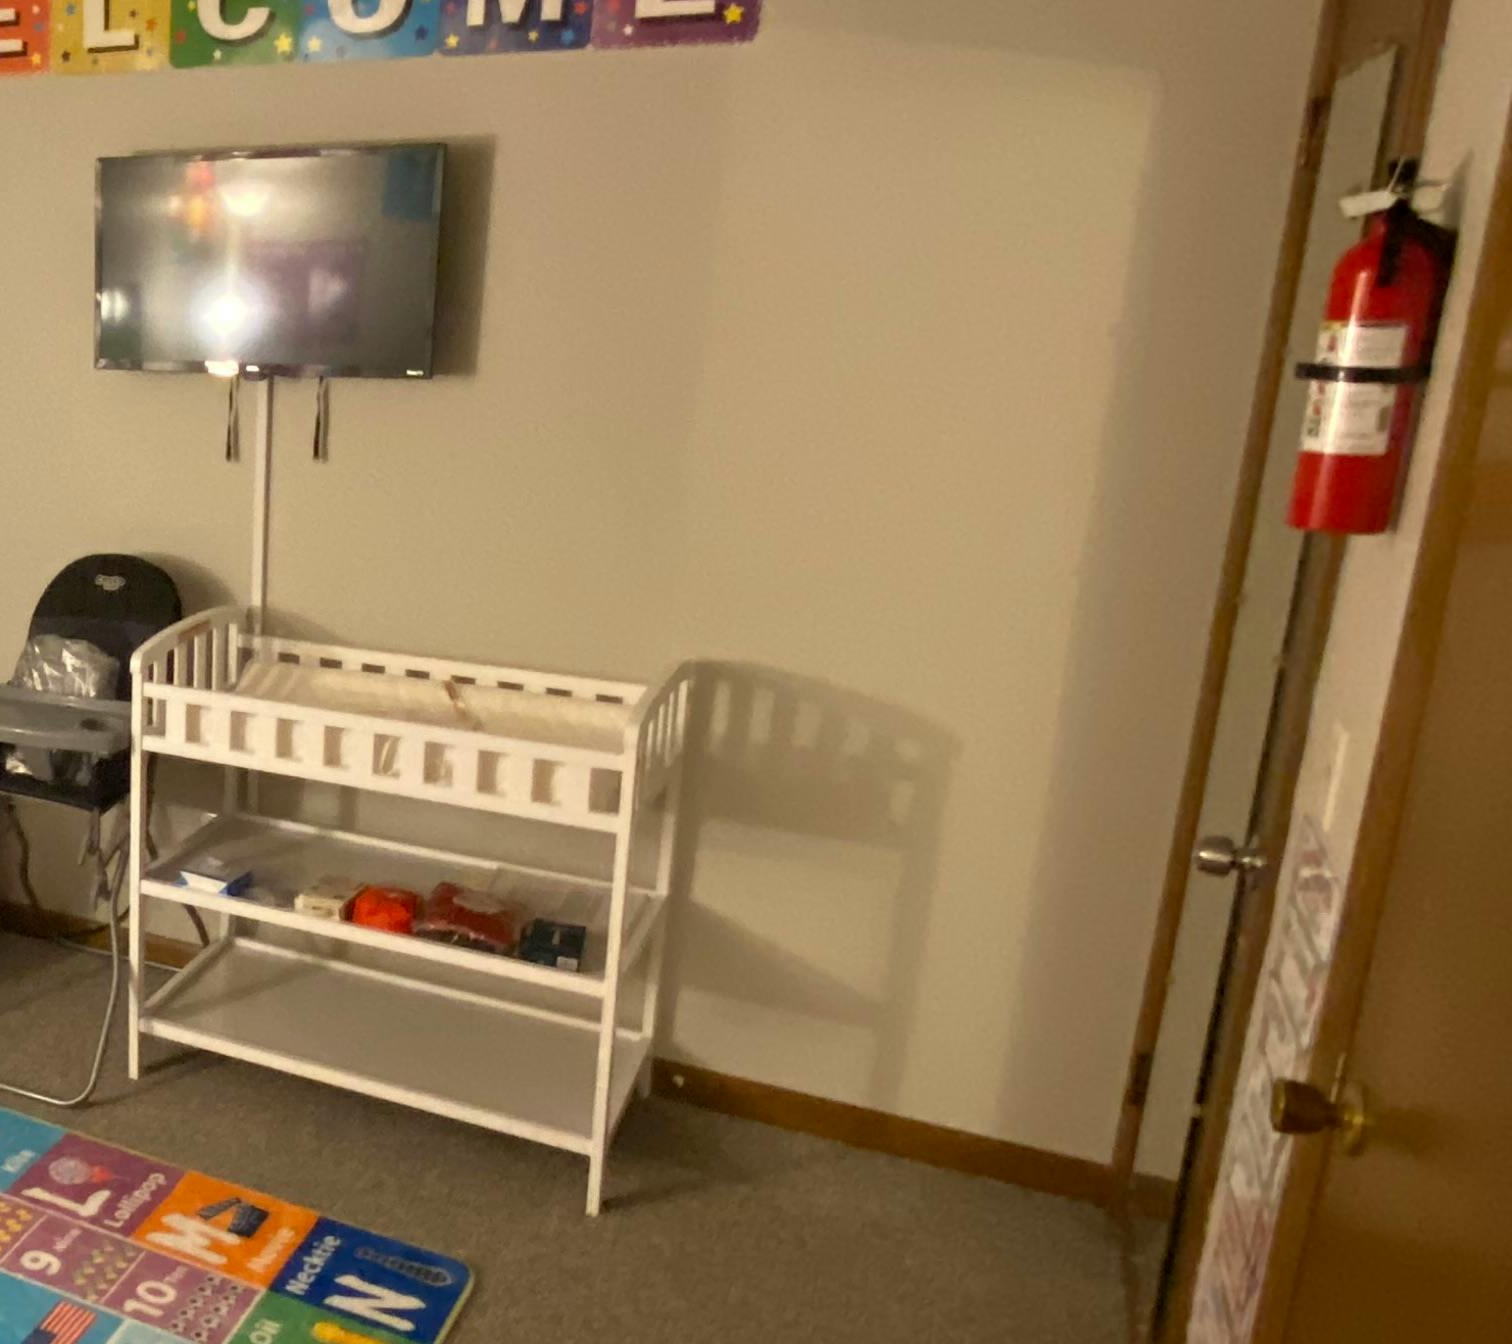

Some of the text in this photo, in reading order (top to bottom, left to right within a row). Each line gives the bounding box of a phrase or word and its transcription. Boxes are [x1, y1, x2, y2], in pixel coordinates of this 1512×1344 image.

[21, 1186, 111, 1217] L
[104, 1172, 167, 1229] Lollipop
[19, 1249, 62, 1277] 9
[146, 1212, 244, 1266] M
[284, 1235, 342, 1296] Necktie
[123, 1280, 178, 1318] 10
[323, 1274, 427, 1333] N
